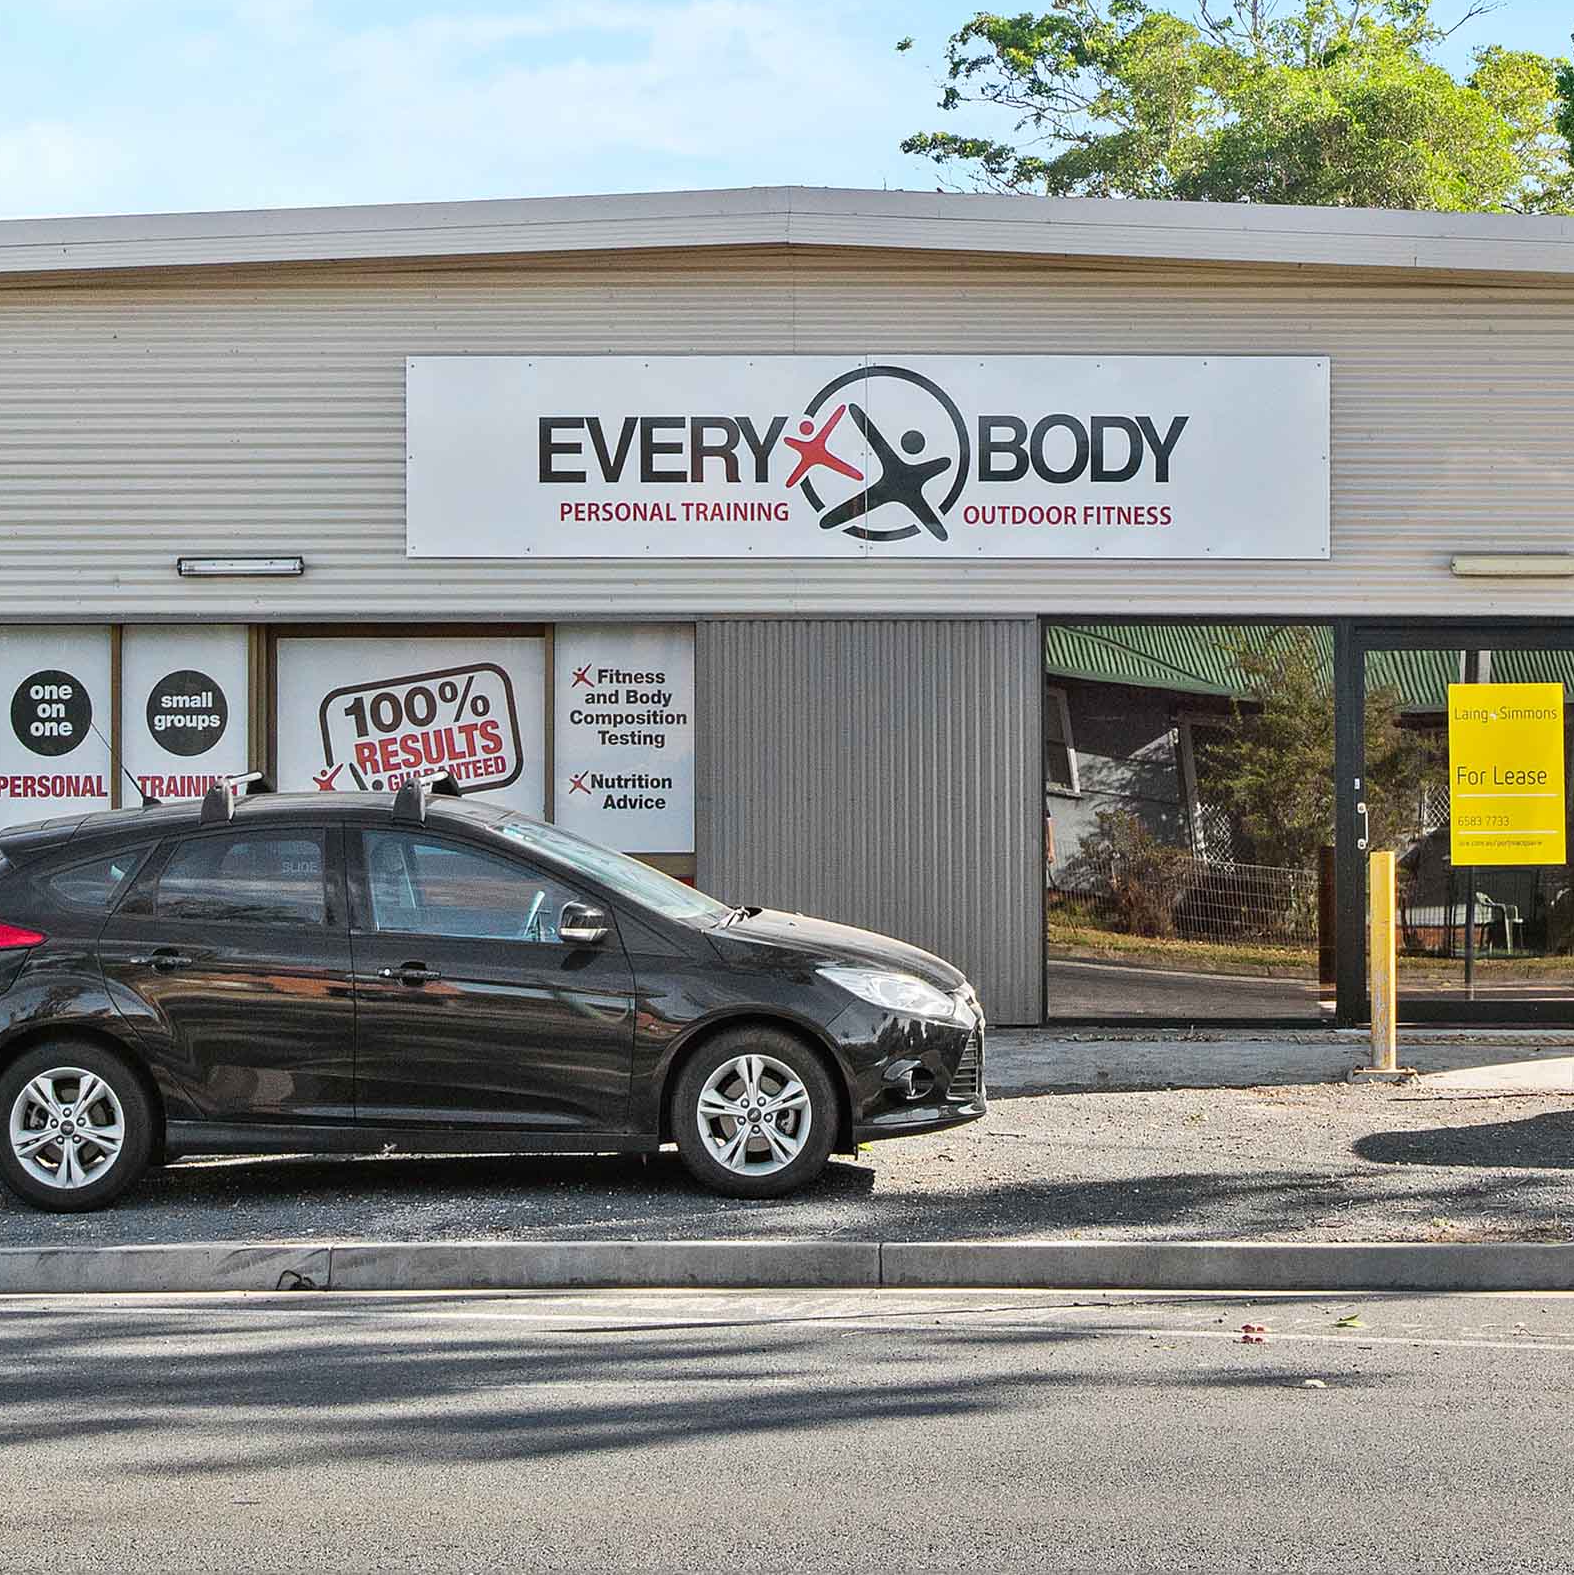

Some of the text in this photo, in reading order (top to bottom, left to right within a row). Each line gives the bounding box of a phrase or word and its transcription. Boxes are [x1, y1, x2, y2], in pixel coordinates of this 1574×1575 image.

[538, 414, 1190, 484] EVERY BODY
[560, 502, 789, 522] PERSONAL TRAINING
[963, 506, 1172, 526] OUTDOOR FITNESS
[597, 669, 666, 684] Fitness
[30, 685, 73, 700] one
[161, 691, 213, 708] small
[585, 690, 672, 707] and Body
[37, 703, 65, 718] on
[344, 676, 491, 738] 100%
[154, 714, 221, 730] groups
[570, 710, 687, 728] Composition
[30, 721, 73, 737] one
[597, 730, 666, 748] Testing
[354, 720, 503, 776] RESULTS
[591, 774, 672, 789] Nutrition
[1457, 765, 1547, 785] For Lease
[137, 775, 237, 797] TRAINI
[602, 794, 666, 809] Advice
